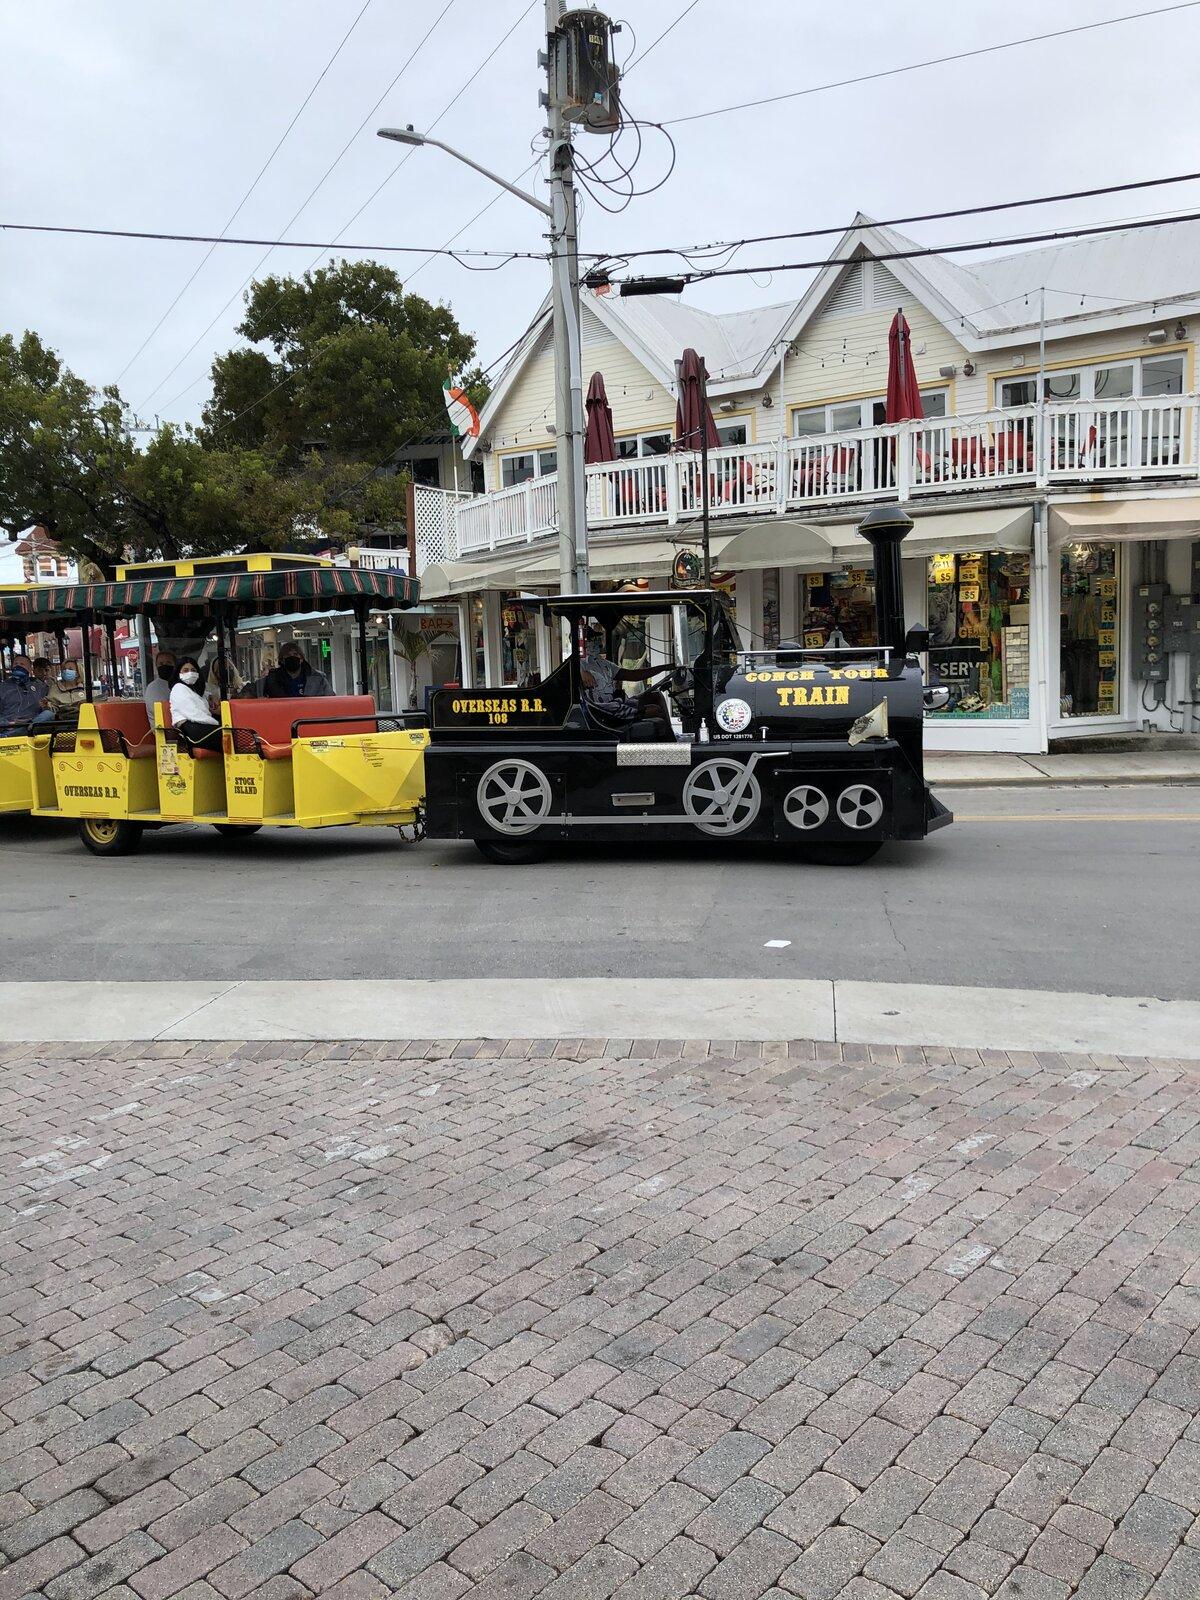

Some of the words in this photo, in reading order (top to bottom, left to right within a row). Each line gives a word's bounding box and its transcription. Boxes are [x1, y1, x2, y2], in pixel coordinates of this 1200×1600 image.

[810, 577, 819, 585] $5
[851, 574, 861, 582] $5
[940, 573, 951, 581] $5
[1104, 585, 1112, 593] $5
[964, 591, 975, 599] $5
[1104, 612, 1113, 620] $5
[420, 618, 442, 630] BAR
[806, 637, 819, 646] $5
[1103, 635, 1112, 644] $5
[745, 670, 815, 682] CONCH
[829, 668, 889, 680] TOUR
[777, 685, 849, 706] TRAIN
[452, 699, 517, 713] OVERSEAS
[521, 699, 547, 712] R.R.
[489, 713, 508, 724] 108
[235, 777, 255, 785] STOCK
[64, 786, 103, 798] OVERSEAS
[105, 787, 120, 799] R.R.
[234, 786, 258, 795] ISLAND
